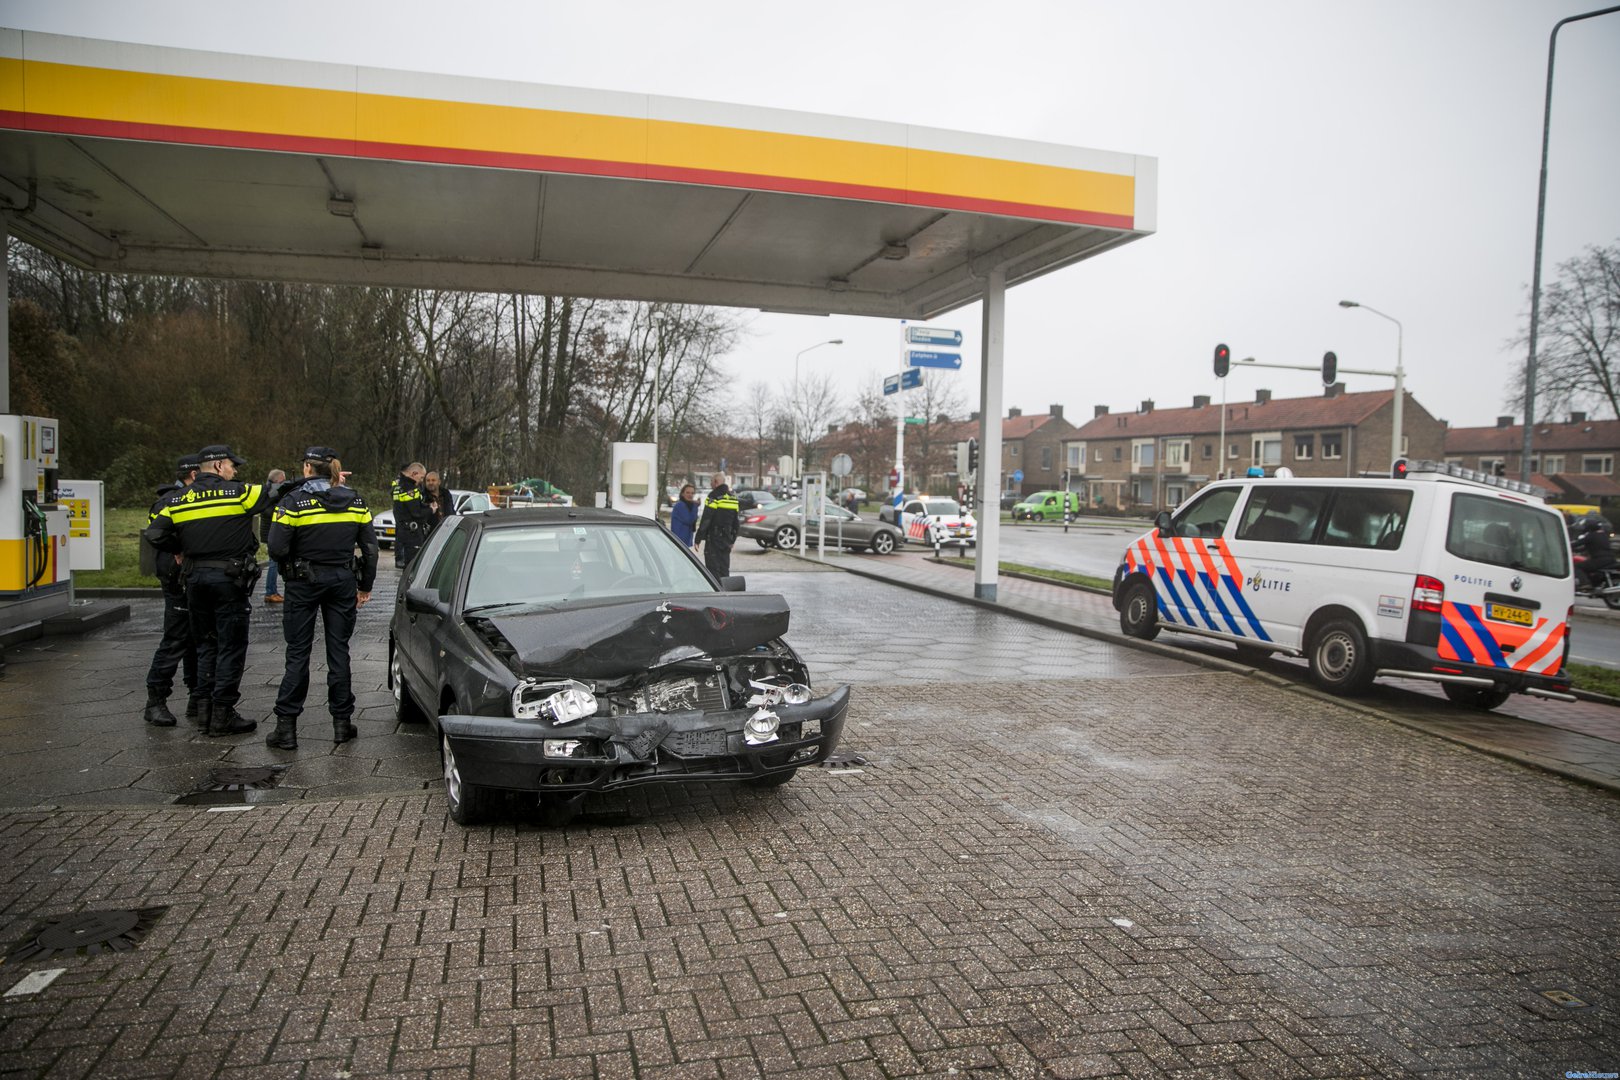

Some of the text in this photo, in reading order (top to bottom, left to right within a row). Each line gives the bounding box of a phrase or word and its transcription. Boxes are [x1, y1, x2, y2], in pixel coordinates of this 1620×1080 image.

[181, 488, 225, 503] POLITIE
[1246, 575, 1292, 592] POLITIE
[1454, 574, 1493, 588] POLITIE
